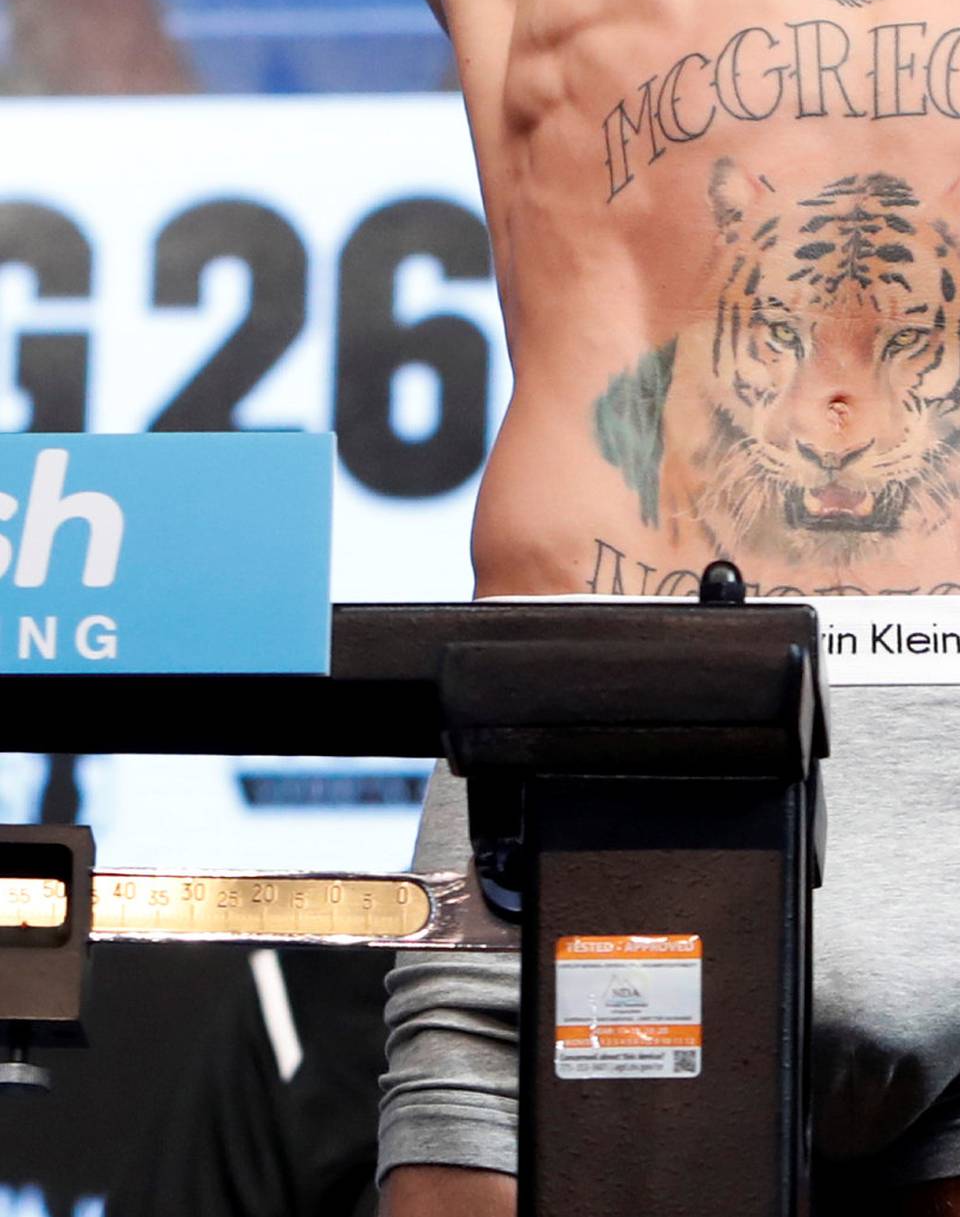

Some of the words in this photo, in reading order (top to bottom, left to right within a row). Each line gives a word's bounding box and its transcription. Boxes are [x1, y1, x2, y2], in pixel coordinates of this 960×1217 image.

[0, 448, 124, 587] h
[113, 882, 136, 900] 40
[148, 889, 170, 906] 35
[182, 882, 206, 901] 30
[217, 891, 240, 908] 25
[252, 883, 276, 903] 20
[290, 891, 306, 910] 15
[325, 884, 343, 904] 10
[362, 893, 374, 910] 5
[396, 886, 409, 905] 0
